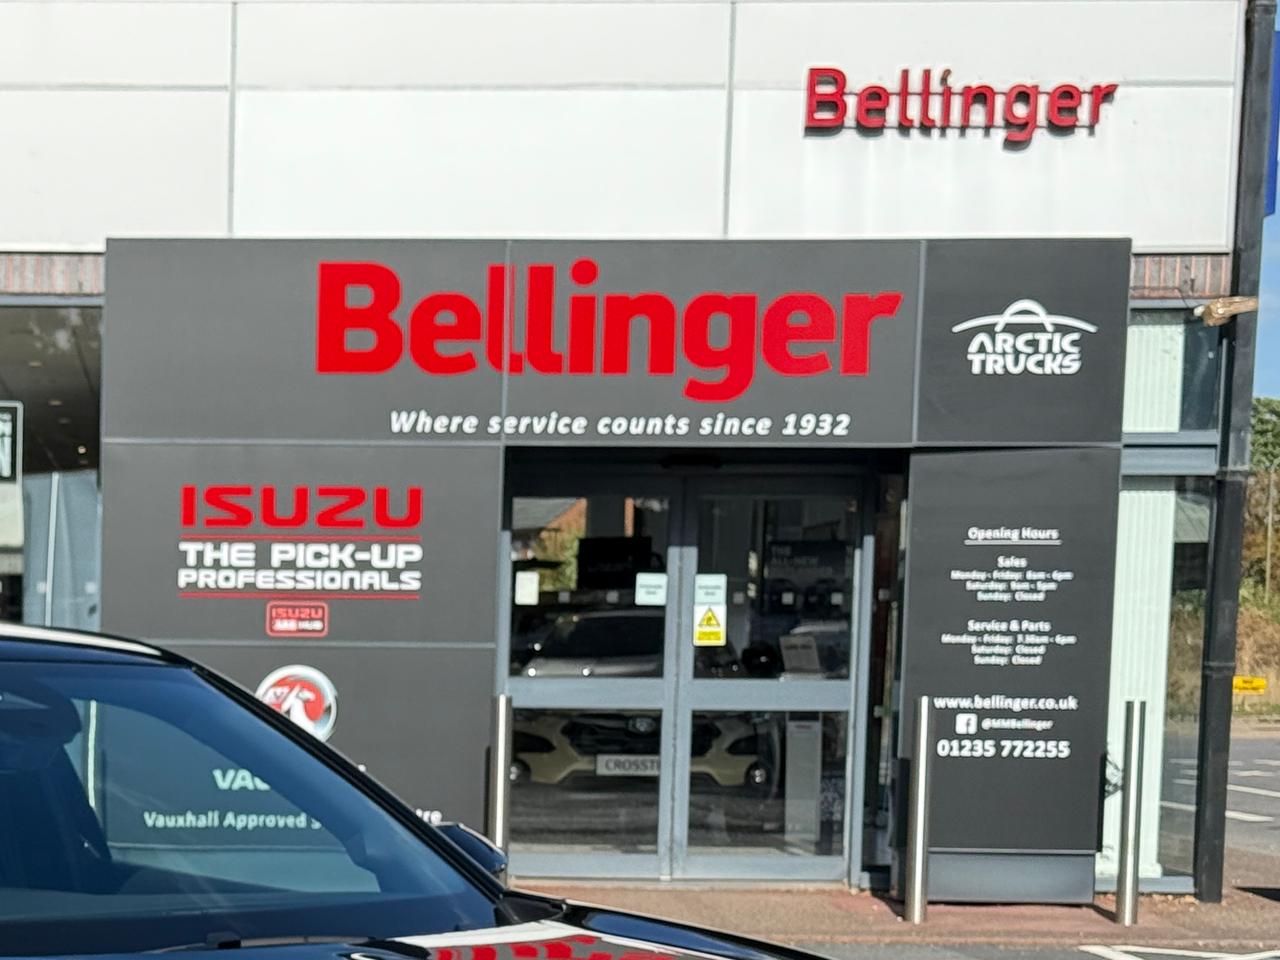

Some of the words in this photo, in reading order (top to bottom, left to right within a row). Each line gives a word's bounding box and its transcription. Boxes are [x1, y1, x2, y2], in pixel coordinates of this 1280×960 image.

[805, 67, 1117, 142] Bellinger
[316, 258, 902, 403] Bellinger
[967, 332, 1082, 354] ARCTIC
[967, 354, 1082, 376] TRUCKS
[391, 410, 478, 435] Where
[488, 410, 587, 437] service
[597, 412, 690, 437] counts
[699, 412, 771, 436] since
[782, 414, 851, 437] 1932
[180, 485, 423, 529] ISUZU
[967, 527, 1020, 541] Opening
[1022, 527, 1059, 540] Hours
[178, 542, 256, 568] THE
[271, 542, 423, 571] PICK-UP
[997, 556, 1028, 568] Sales
[177, 569, 422, 591] PROFESSIONALS
[950, 570, 986, 581] Monday
[993, 570, 1022, 581] Friday:
[966, 581, 1008, 592] Saturday:
[977, 591, 1012, 602] Sunday:
[1015, 591, 1046, 601] Closed
[272, 607, 323, 618] ISUZU
[967, 619, 1008, 631] Service
[1009, 620, 1019, 631] &
[1021, 620, 1052, 632] Parts
[941, 633, 977, 644] Monday
[983, 634, 1013, 645] Friday:
[971, 644, 1013, 655] Saturday:
[1015, 644, 1046, 654] Closed
[973, 654, 1009, 666] Sunday:
[1011, 655, 1043, 665] Closed
[933, 695, 1079, 712] www.bellinger.co.uk
[937, 739, 997, 758] 01235
[1000, 740, 1071, 759] 772255
[143, 810, 219, 828] Vauxhall
[223, 811, 307, 831] Approved
